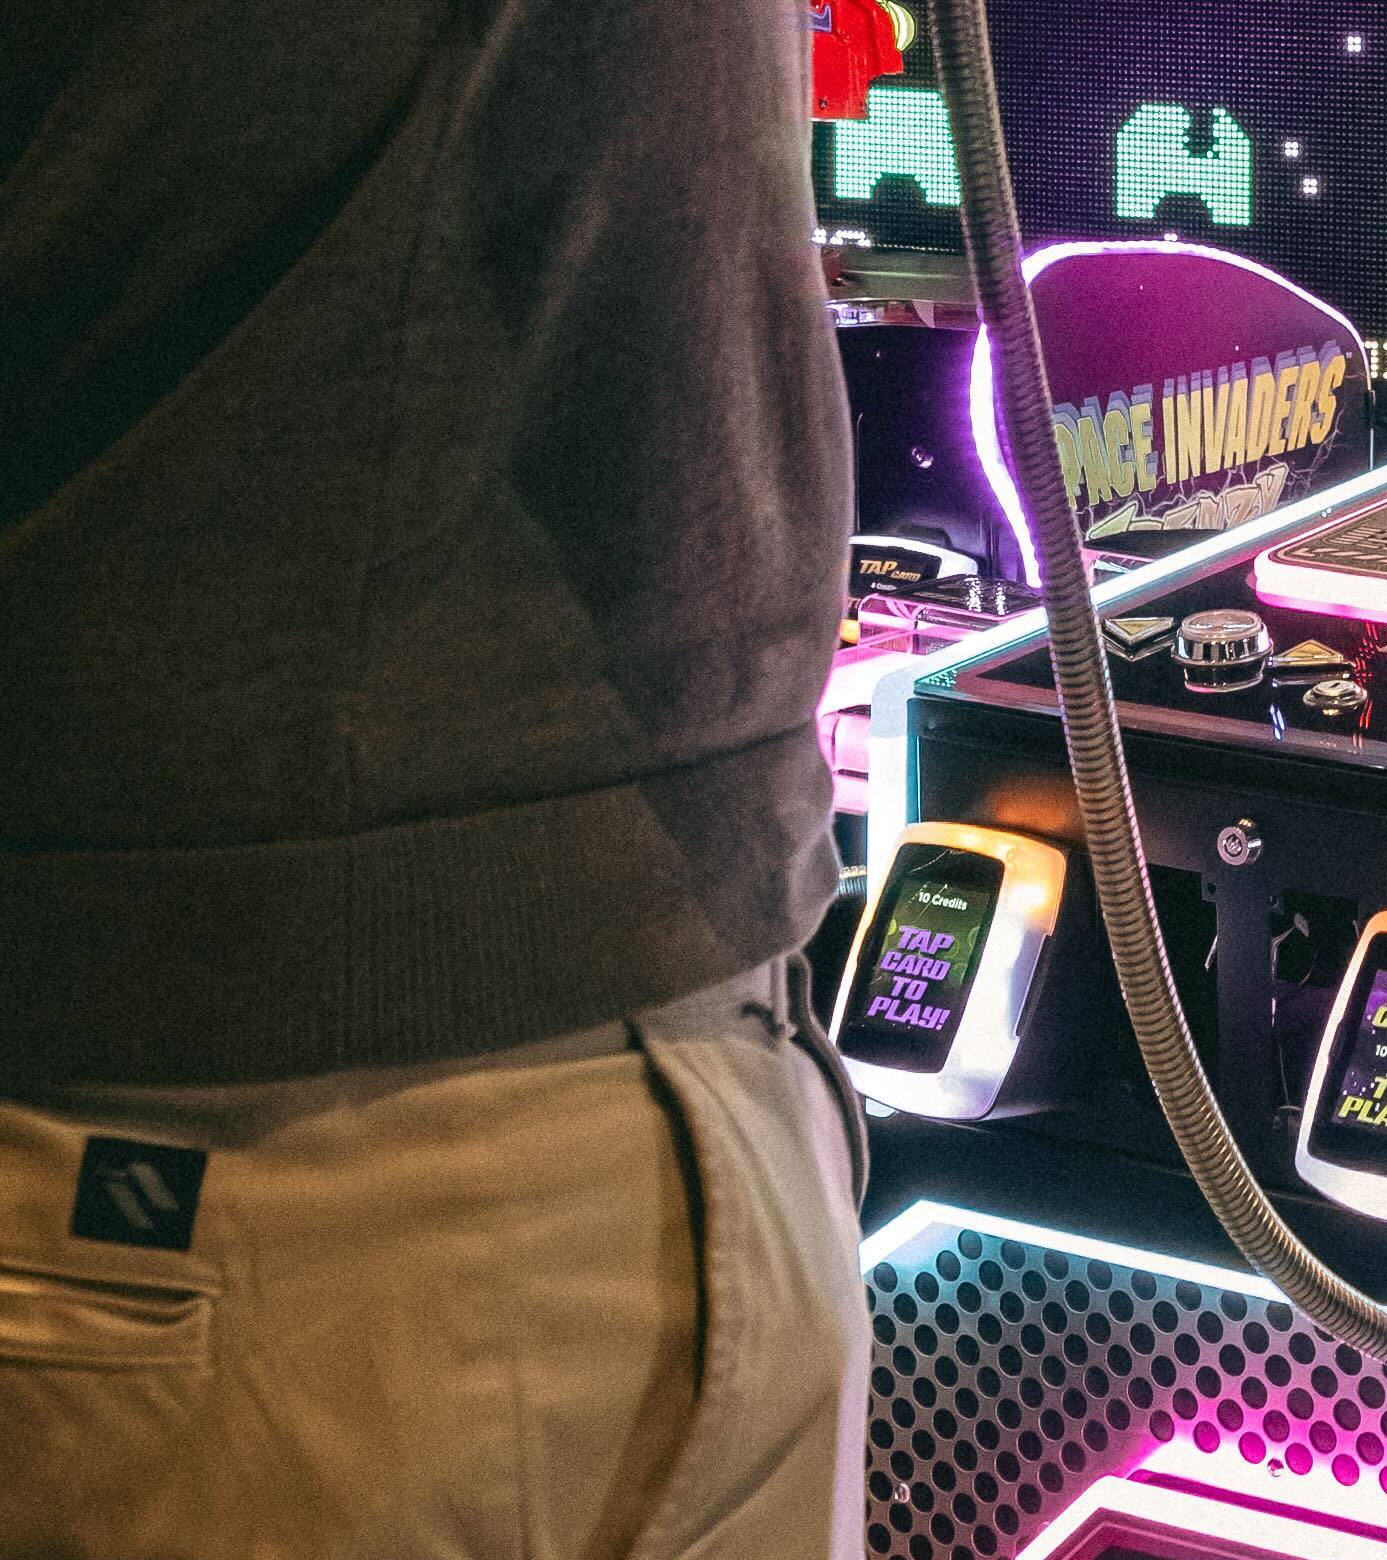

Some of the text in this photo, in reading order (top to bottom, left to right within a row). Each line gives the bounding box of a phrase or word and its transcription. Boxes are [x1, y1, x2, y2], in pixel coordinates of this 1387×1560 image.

[1052, 350, 1346, 509] PACE INVADERS
[860, 560, 898, 574] TAP
[917, 891, 968, 911] 10 Credits
[897, 925, 955, 955] TAP
[880, 950, 951, 981] CARD
[891, 975, 928, 1001] TO
[867, 995, 951, 1030] PLAY!
